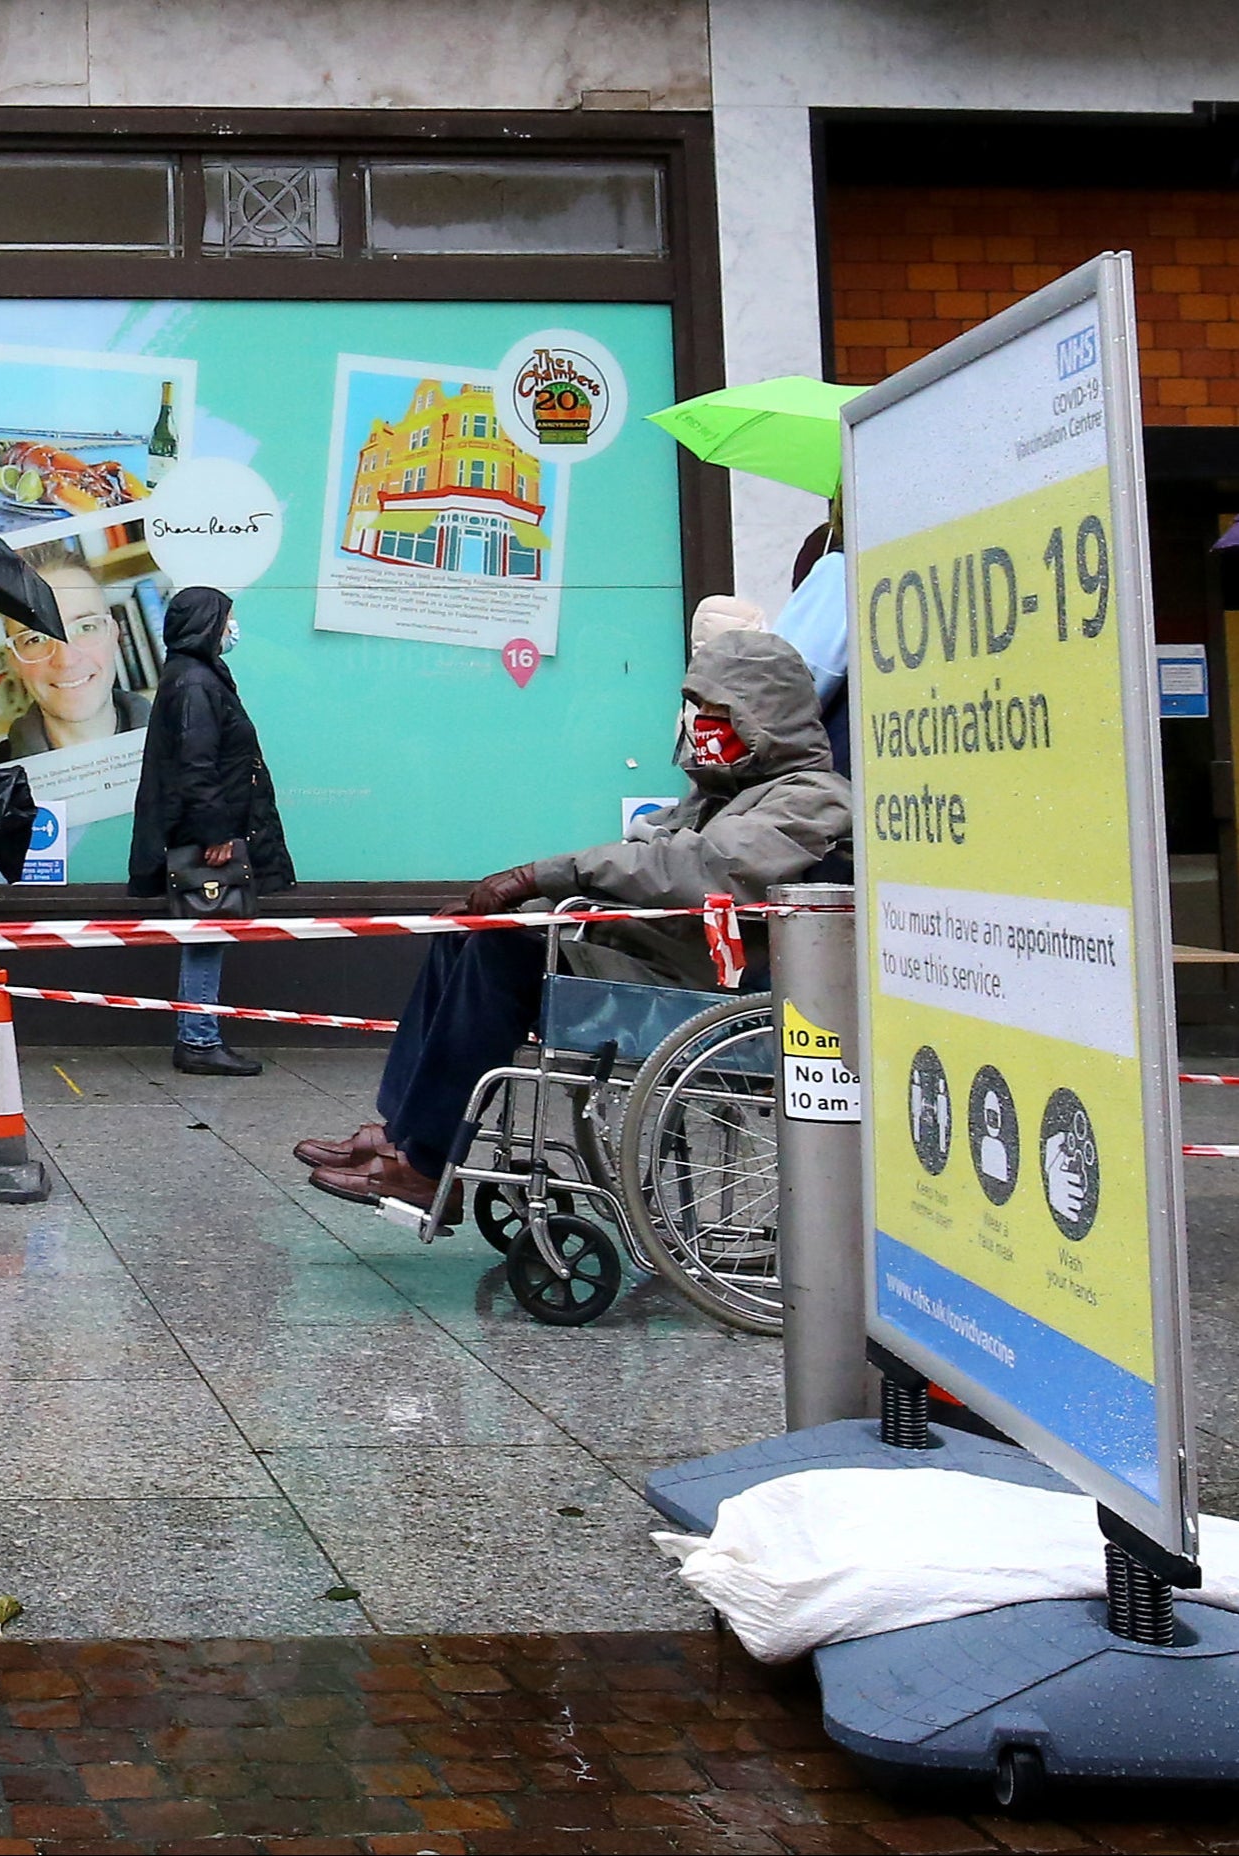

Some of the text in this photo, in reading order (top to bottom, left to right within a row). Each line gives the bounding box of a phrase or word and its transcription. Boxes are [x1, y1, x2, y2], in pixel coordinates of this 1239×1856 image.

[533, 349, 565, 371] The
[1059, 332, 1095, 376] NHS
[518, 361, 600, 398] Chambers
[1053, 377, 1099, 416] COVID-19
[535, 389, 579, 410] 20
[1015, 409, 1103, 461] Vaccination Centre
[869, 515, 1109, 674] COVID-19
[507, 648, 534, 668] 16
[872, 678, 1050, 758] vaccination
[874, 784, 966, 844] centre
[882, 901, 1116, 967] You must have an appointment
[882, 949, 1006, 999] to use this service.
[789, 1030, 810, 1047] 10
[796, 1065, 823, 1083] No
[791, 1092, 811, 1109] 10
[817, 1098, 848, 1111] am
[1058, 1248, 1083, 1275] Wash
[1046, 1269, 1098, 1306] your hands
